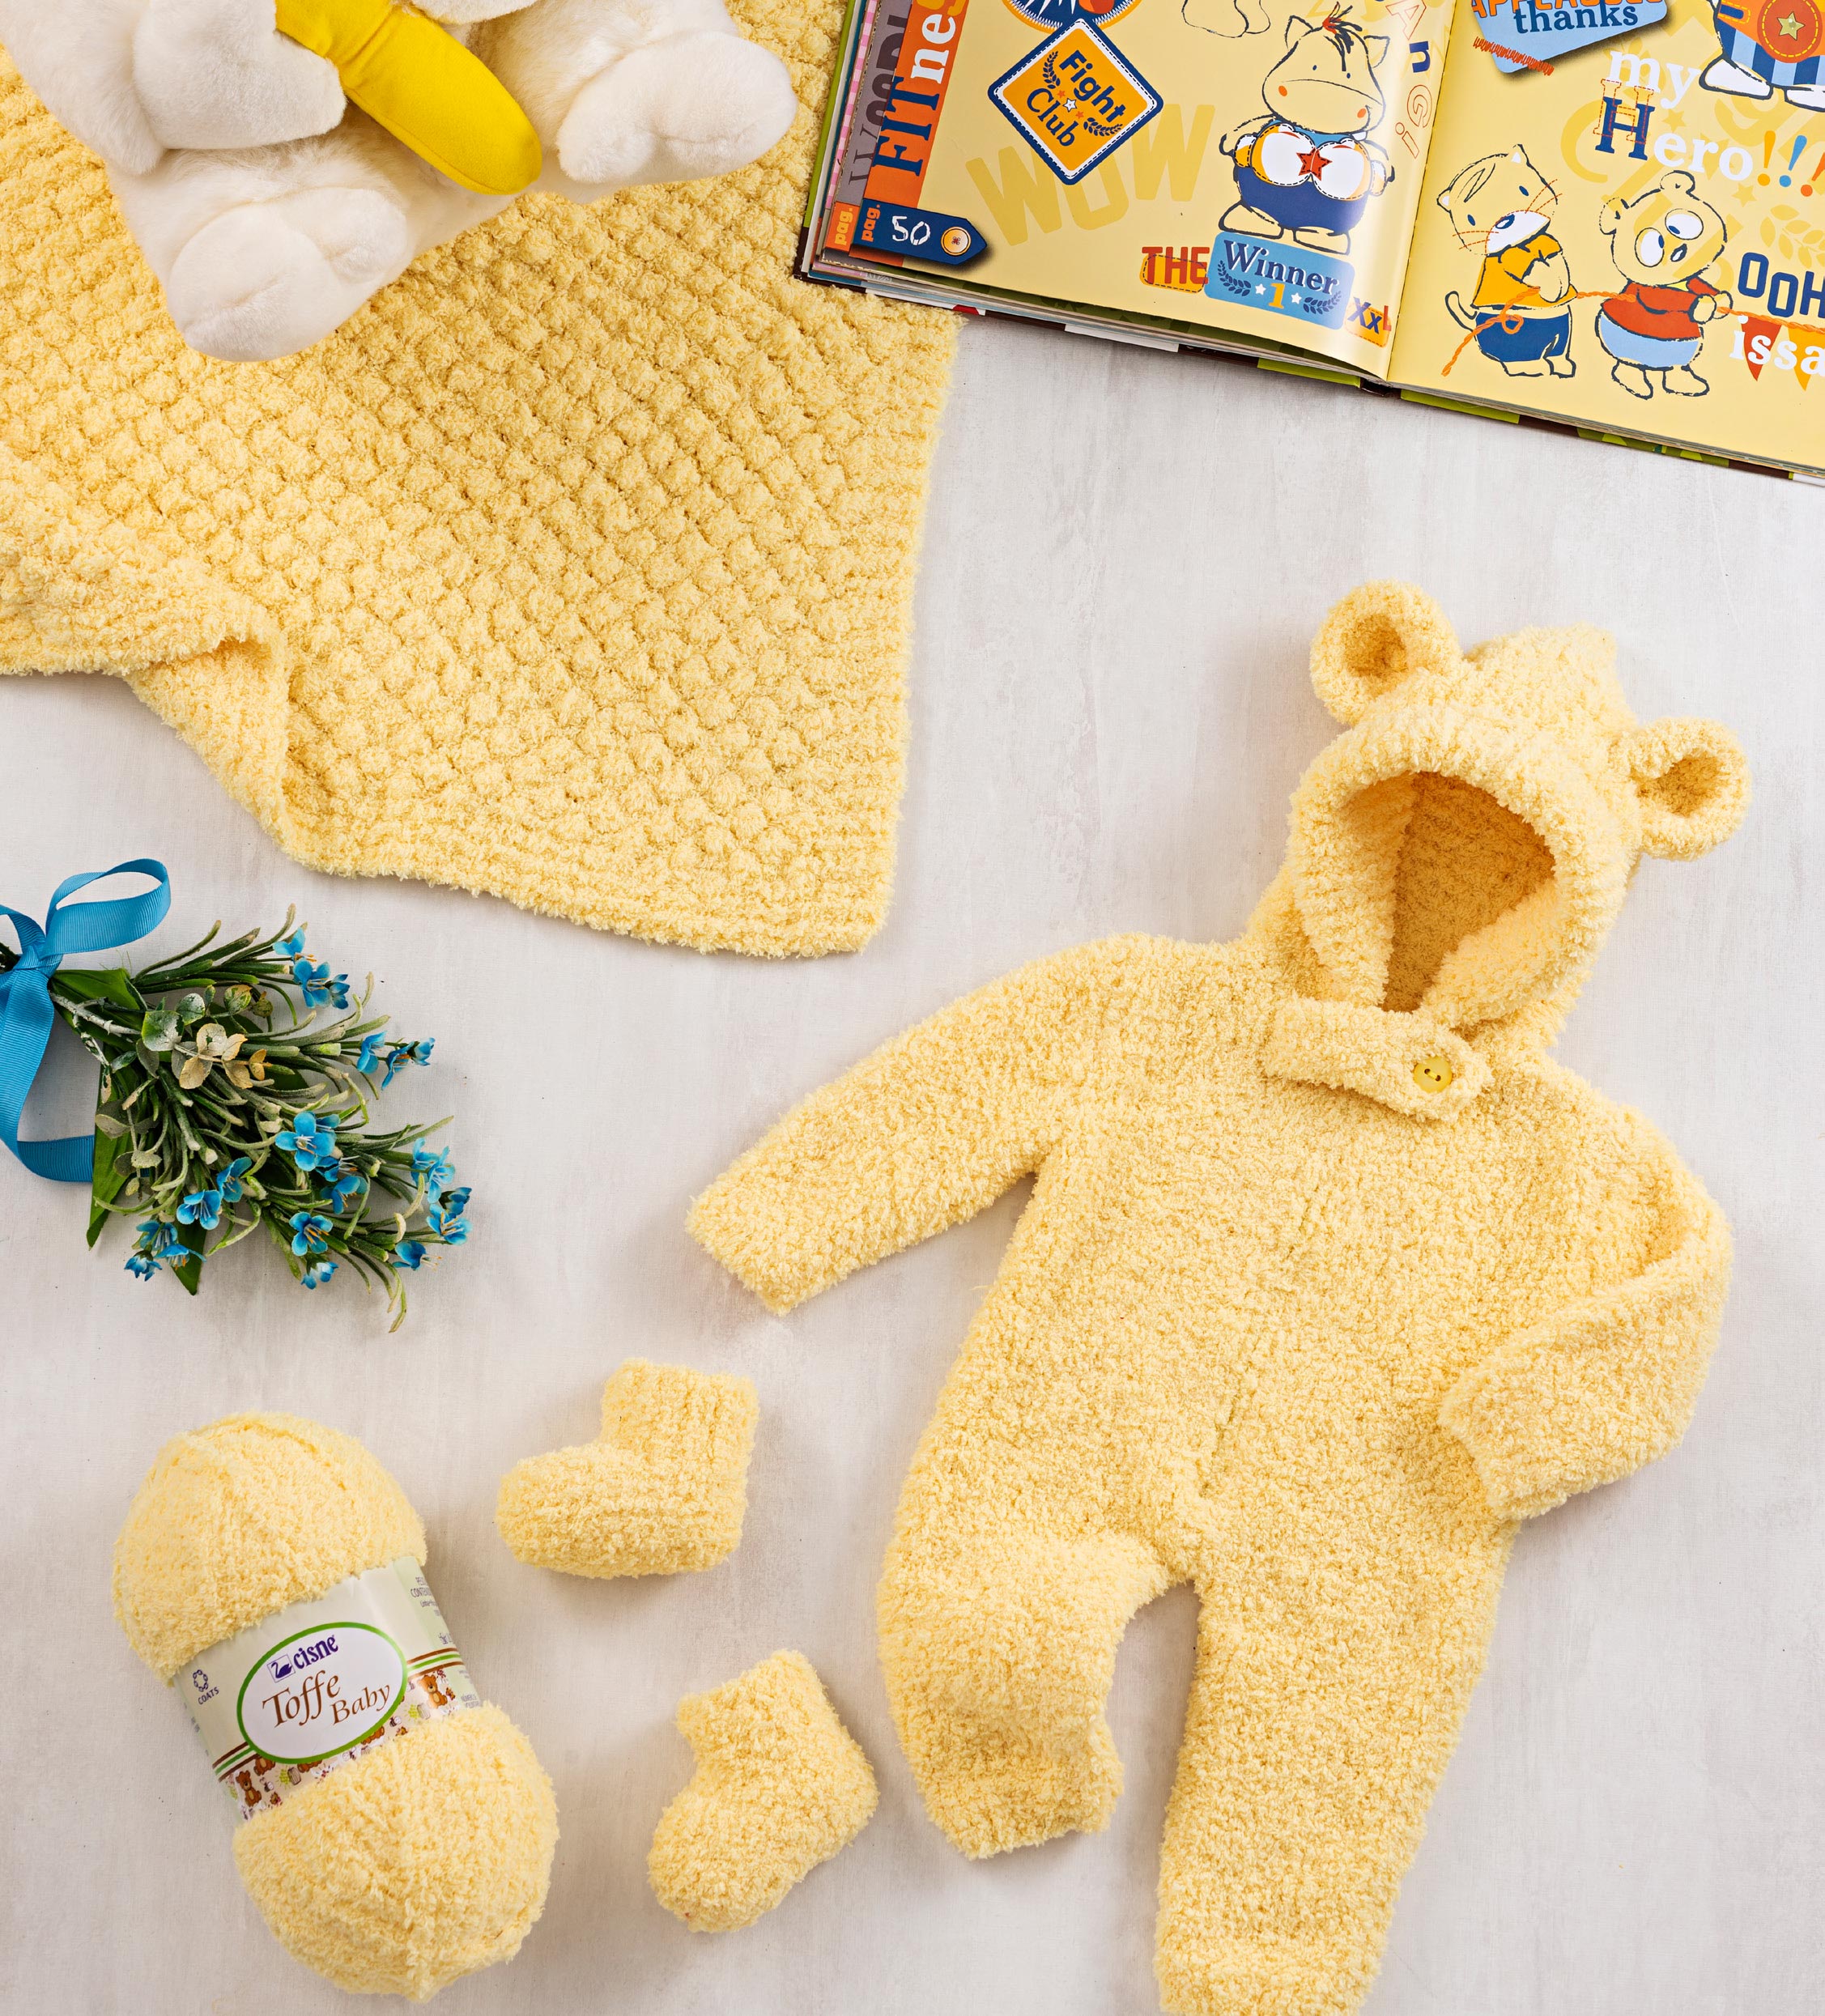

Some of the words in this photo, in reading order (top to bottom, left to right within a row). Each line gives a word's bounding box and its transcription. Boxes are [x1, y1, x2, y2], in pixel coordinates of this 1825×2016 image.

[1513, 0, 1639, 34] thanks
[1059, 49, 1127, 123] Fight
[1606, 50, 1701, 109] my
[1027, 87, 1076, 147] Club
[835, 207, 853, 246] pag.
[861, 204, 881, 242] pag.
[891, 215, 930, 245] 50
[1142, 246, 1210, 284] THE
[1223, 240, 1340, 296] Winner
[1268, 283, 1285, 309] 1
[293, 1635, 338, 1669] cisne
[198, 1686, 219, 1705] COATS
[262, 1669, 341, 1729] Toffe
[330, 1685, 390, 1726] Baby
